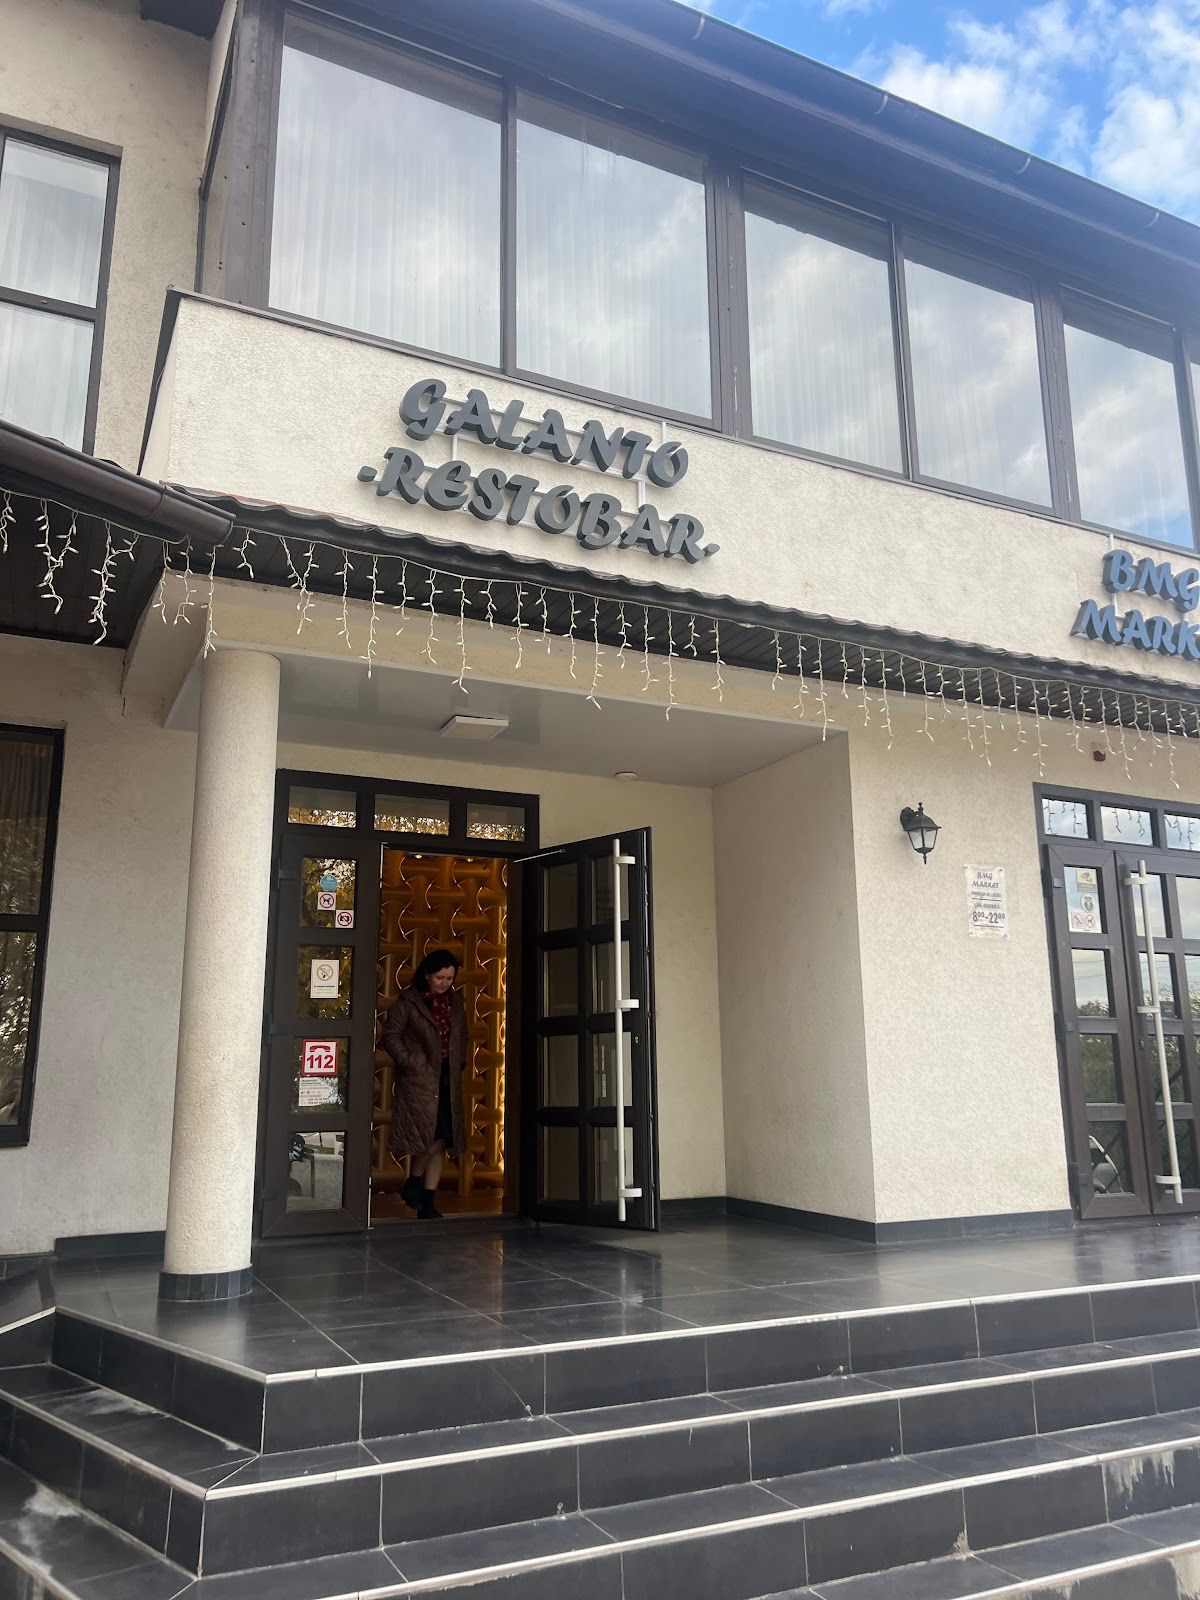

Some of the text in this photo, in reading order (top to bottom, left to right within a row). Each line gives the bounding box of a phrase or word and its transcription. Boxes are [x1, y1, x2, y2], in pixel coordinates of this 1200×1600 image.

[399, 378, 689, 488] GALANTO
[1102, 549, 1200, 613] BMG
[972, 880, 999, 889] MARKET
[306, 1054, 334, 1069] 112
